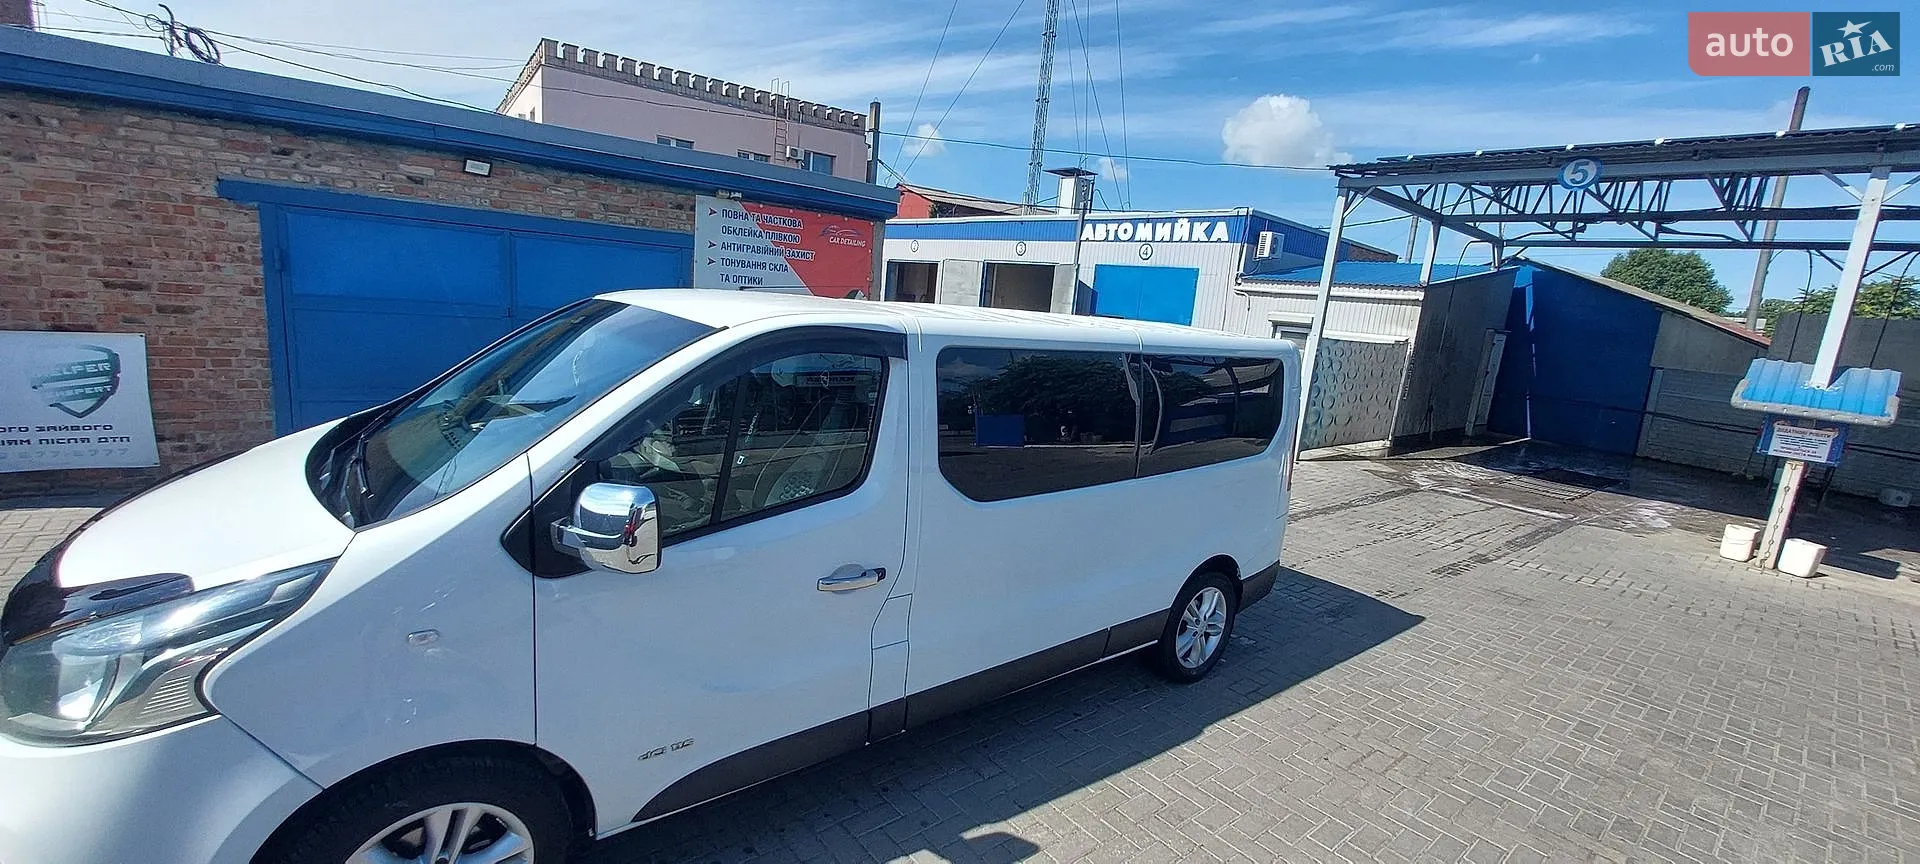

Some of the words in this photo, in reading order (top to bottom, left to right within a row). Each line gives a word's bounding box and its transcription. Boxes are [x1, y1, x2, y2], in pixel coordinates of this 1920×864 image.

[1570, 161, 1589, 184] 5
[721, 208, 749, 221] ПОВНА
[750, 213, 762, 223] ТА
[763, 215, 803, 228] ЧАСТКОВА
[721, 225, 763, 238] ОБКЛЕЙКА
[765, 231, 800, 243] ПЛІВКОЮ
[1080, 218, 1229, 242] АВТОМИЙКА
[829, 236, 840, 245] CAR
[840, 238, 866, 247] DETAILING
[720, 241, 784, 257] АНТИГРАВІЙНИЙ
[785, 249, 815, 260] ЗАХИСТ
[720, 258, 767, 270] ТОНУВАННЯ
[768, 263, 789, 273] СКЛА
[720, 273, 730, 283] ТА
[732, 275, 763, 285] ОПТИКИ
[43, 362, 111, 378] ELPER
[35, 424, 113, 432] ЗАЙВОГО
[97, 436, 130, 444] ДТП
